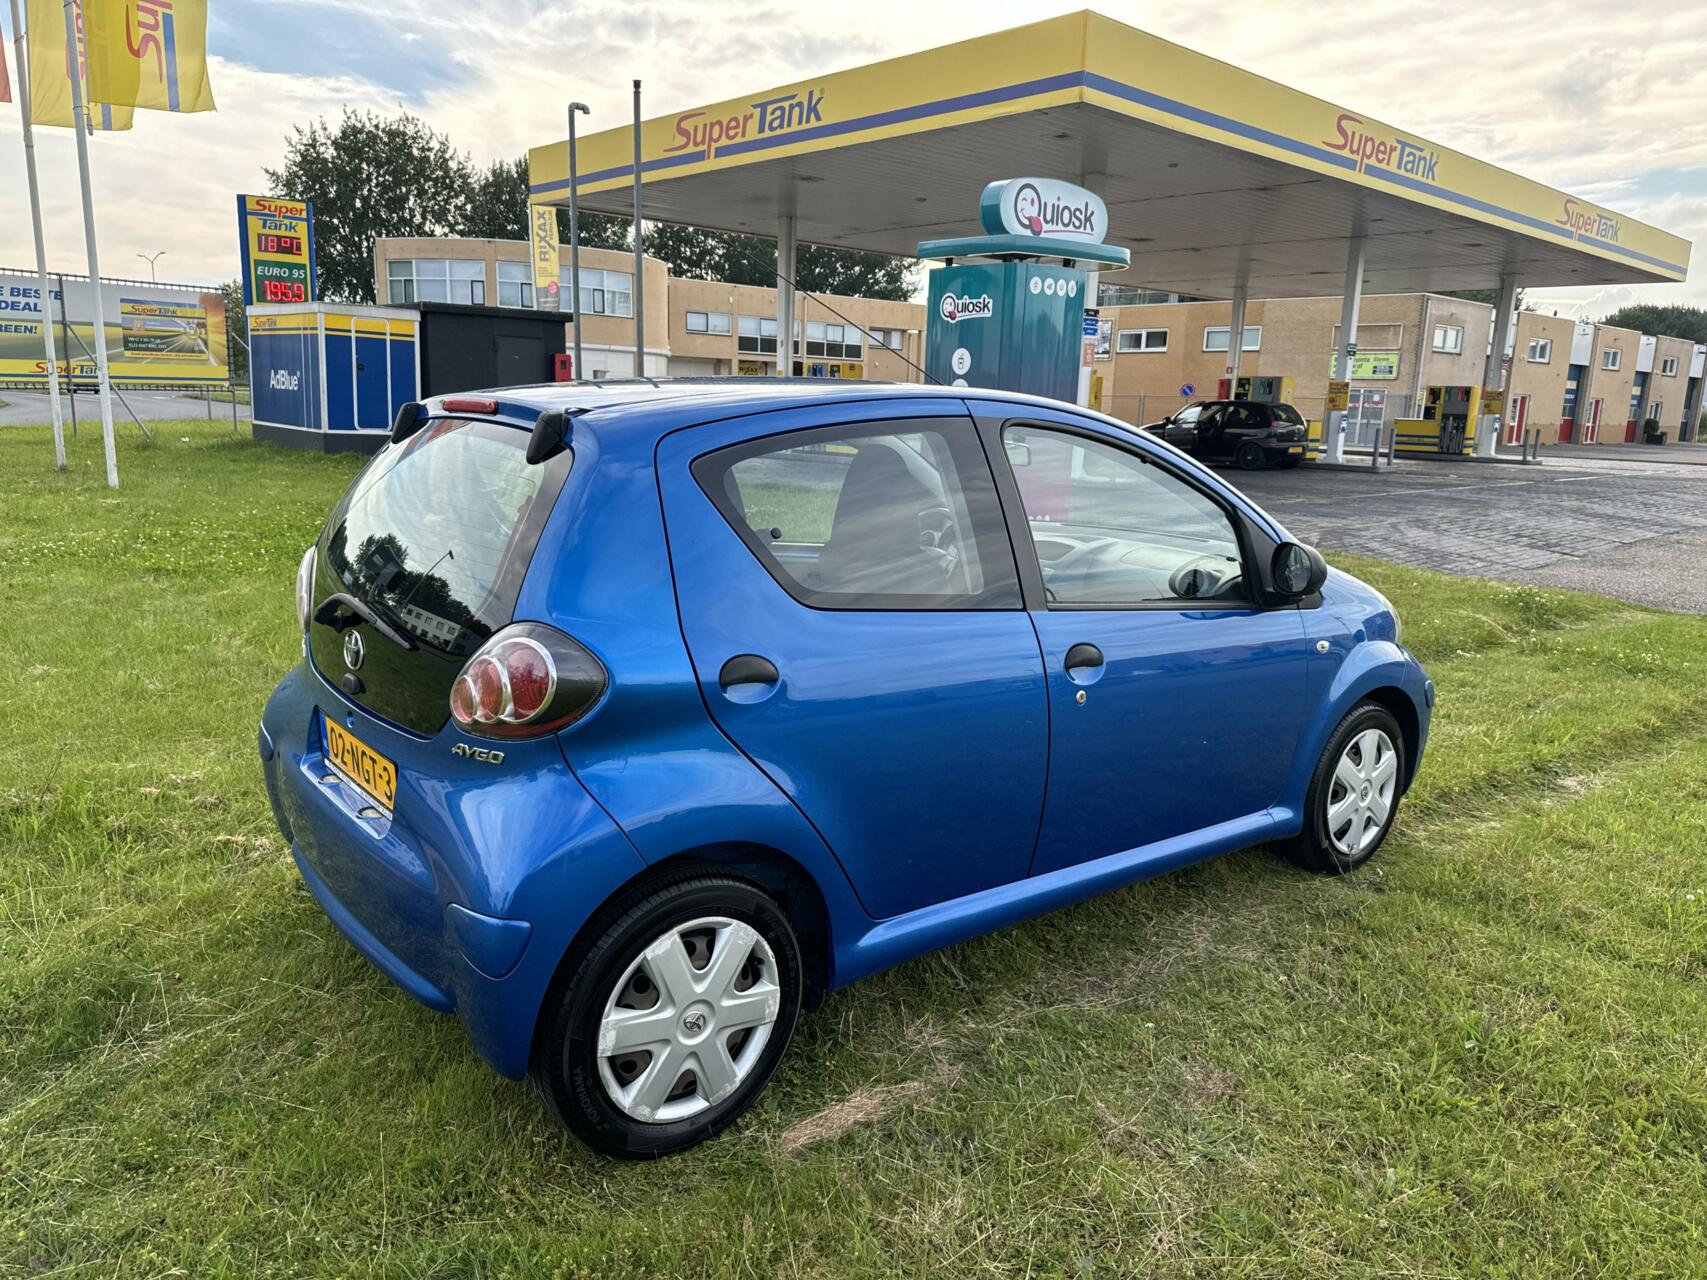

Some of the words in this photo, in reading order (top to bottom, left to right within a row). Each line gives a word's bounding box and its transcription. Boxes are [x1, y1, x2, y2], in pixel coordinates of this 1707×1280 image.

[663, 89, 825, 160] SuperTank
[1321, 113, 1438, 182] SuperTank
[248, 199, 306, 219] Super
[1014, 183, 1094, 236] Quiosk
[1555, 198, 1620, 242] SuperTank
[258, 217, 298, 233] Tank
[257, 266, 289, 278] EURO
[292, 269, 306, 279] 95
[264, 280, 305, 303] 195.9
[0, 300, 42, 312] DEAL
[942, 295, 991, 320] Quiosk
[329, 725, 394, 802] 02-NGT-3
[451, 742, 505, 765] AYGO
